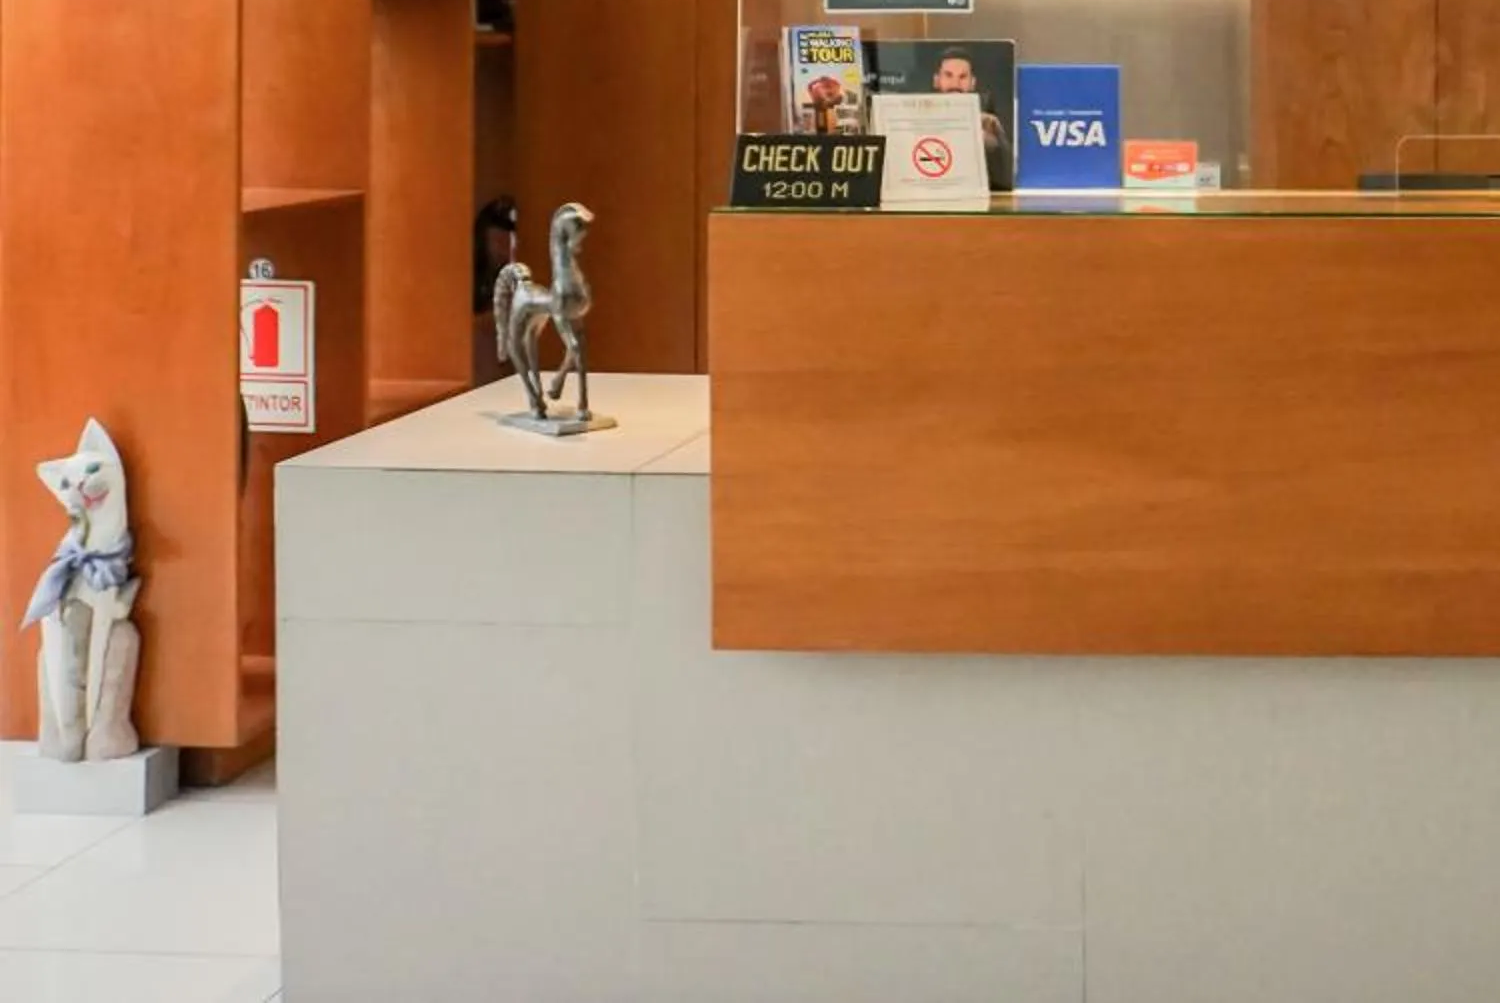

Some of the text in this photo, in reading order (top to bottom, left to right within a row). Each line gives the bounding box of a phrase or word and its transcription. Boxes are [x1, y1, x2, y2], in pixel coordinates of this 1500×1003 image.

[810, 47, 854, 63] TOUR
[1029, 120, 1107, 146] VISA
[742, 144, 880, 173] CHECK OUT
[831, 181, 849, 198] M
[247, 395, 302, 412] TINTOR
